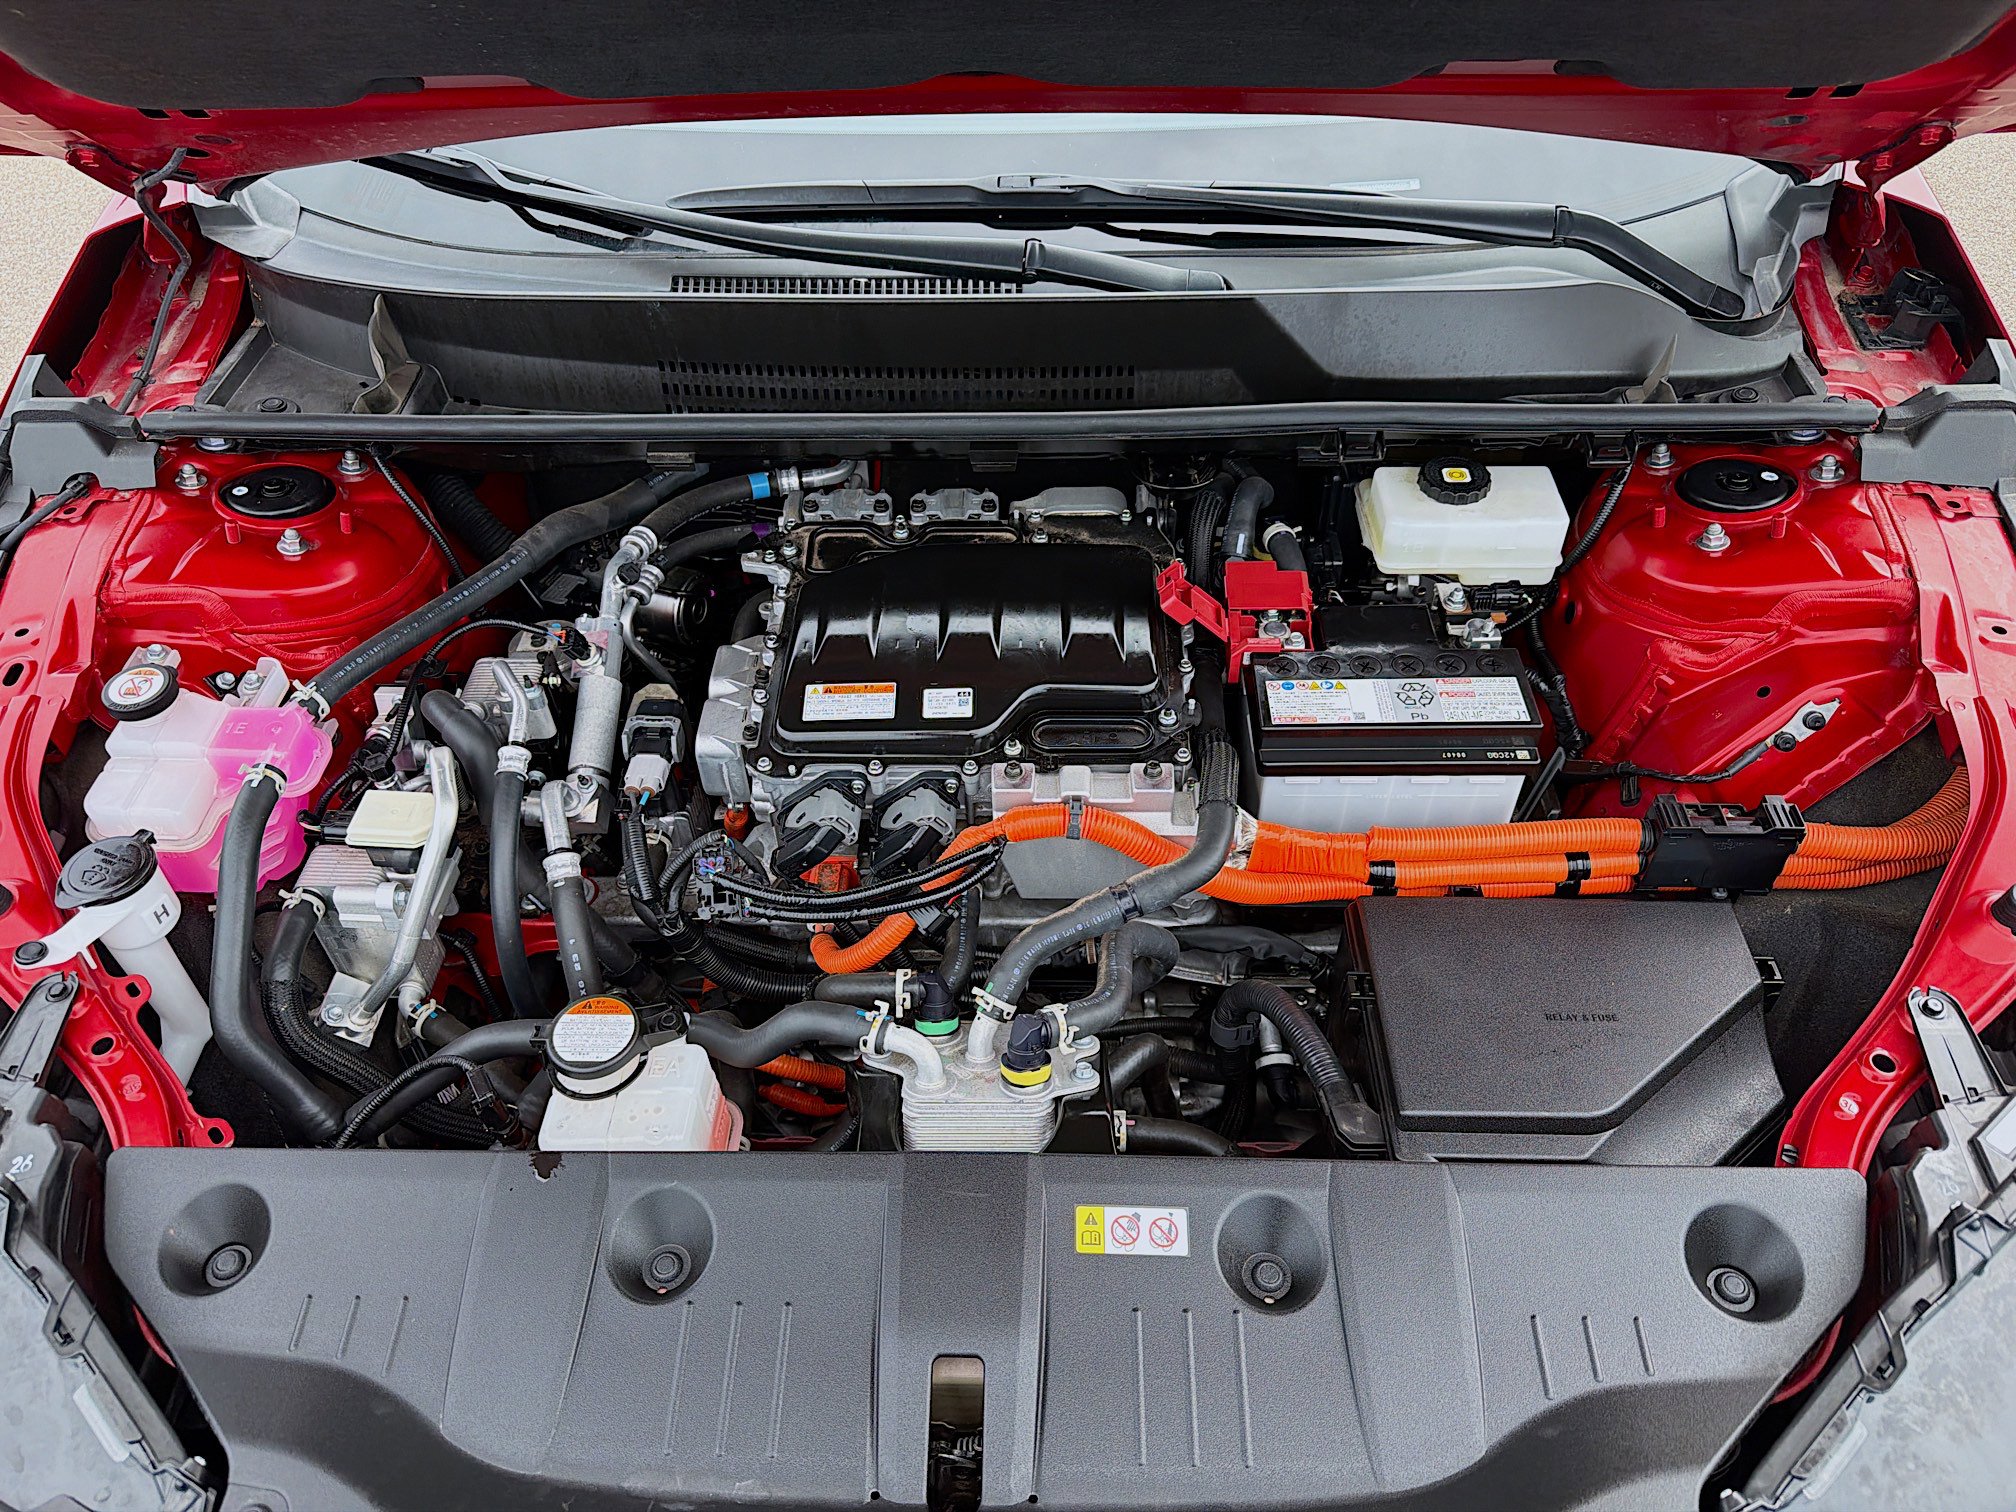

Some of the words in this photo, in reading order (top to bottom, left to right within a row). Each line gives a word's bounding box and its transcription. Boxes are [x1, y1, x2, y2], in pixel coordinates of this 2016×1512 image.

[107, 701, 141, 712] DENSO
[1410, 712, 1429, 721] Pb
[153, 903, 170, 925] H
[1545, 1013, 1578, 1022] RELAY
[1582, 1013, 1589, 1021] &
[1591, 1013, 1620, 1022] FUSE
[1839, 1099, 1856, 1113] 3L
[9, 1153, 35, 1174] 26
